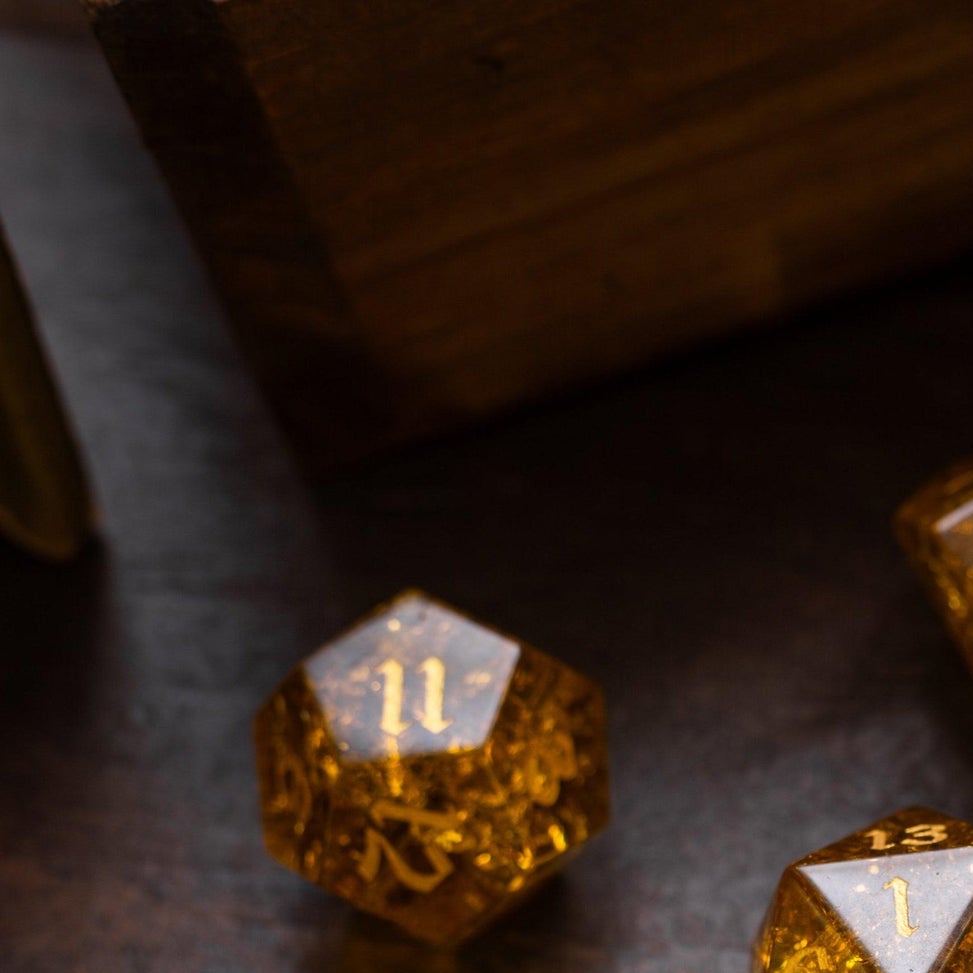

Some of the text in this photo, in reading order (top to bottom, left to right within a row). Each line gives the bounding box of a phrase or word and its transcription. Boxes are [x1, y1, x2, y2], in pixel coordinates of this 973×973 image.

[374, 656, 453, 736] 11
[867, 823, 949, 851] 13
[883, 877, 919, 937] 1
